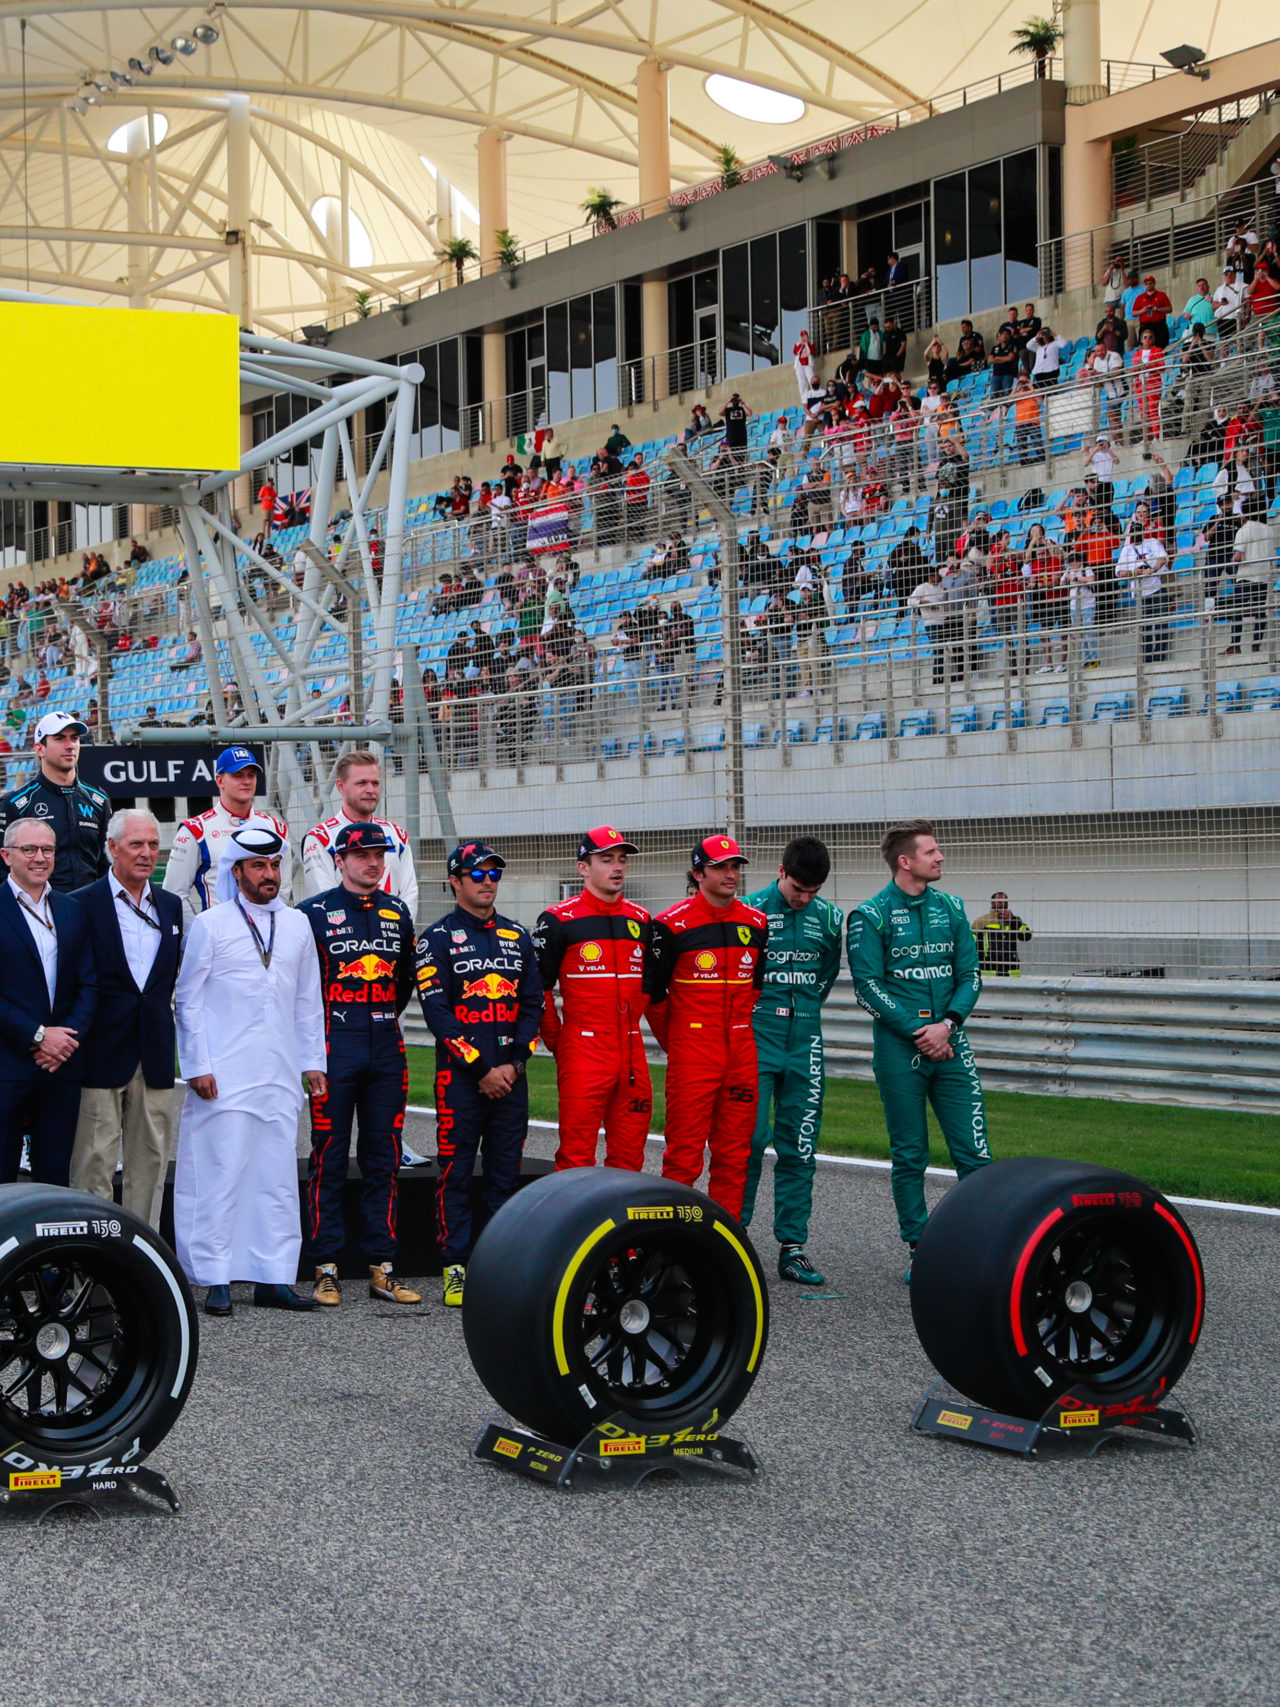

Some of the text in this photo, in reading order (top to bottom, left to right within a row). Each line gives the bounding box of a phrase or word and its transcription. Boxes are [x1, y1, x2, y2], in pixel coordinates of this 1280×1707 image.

[104, 759, 184, 783] GULF
[329, 939, 401, 954] ORACLE
[891, 941, 954, 958] cognizant
[767, 949, 820, 964] ognizant
[453, 958, 523, 974] ORACLE
[893, 964, 953, 980] aramco
[329, 982, 369, 1003] Red
[454, 1001, 494, 1023] Red
[729, 1087, 754, 1103] 55
[798, 1035, 822, 1164] ASTON MARTIN
[436, 1069, 457, 1156] Red Bull
[628, 1099, 651, 1114] 16
[971, 1102, 991, 1160] ASTON
[627, 1206, 674, 1220] PIRELLI
[677, 1205, 703, 1222] 150
[35, 1221, 88, 1237] PIRELLI
[91, 1219, 121, 1238] 150
[942, 1413, 970, 1427] PIRELLI
[992, 1421, 1026, 1433] ZERO
[1063, 1413, 1096, 1425] PIRELLI
[121, 1437, 140, 1463] P
[497, 1440, 563, 1462] PIRELLI P ZERO
[603, 1441, 642, 1453] PIRELLI
[673, 1447, 703, 1456] MEDIUM
[13, 1474, 57, 1487] PIRELLI
[92, 1480, 117, 1491] HARD
